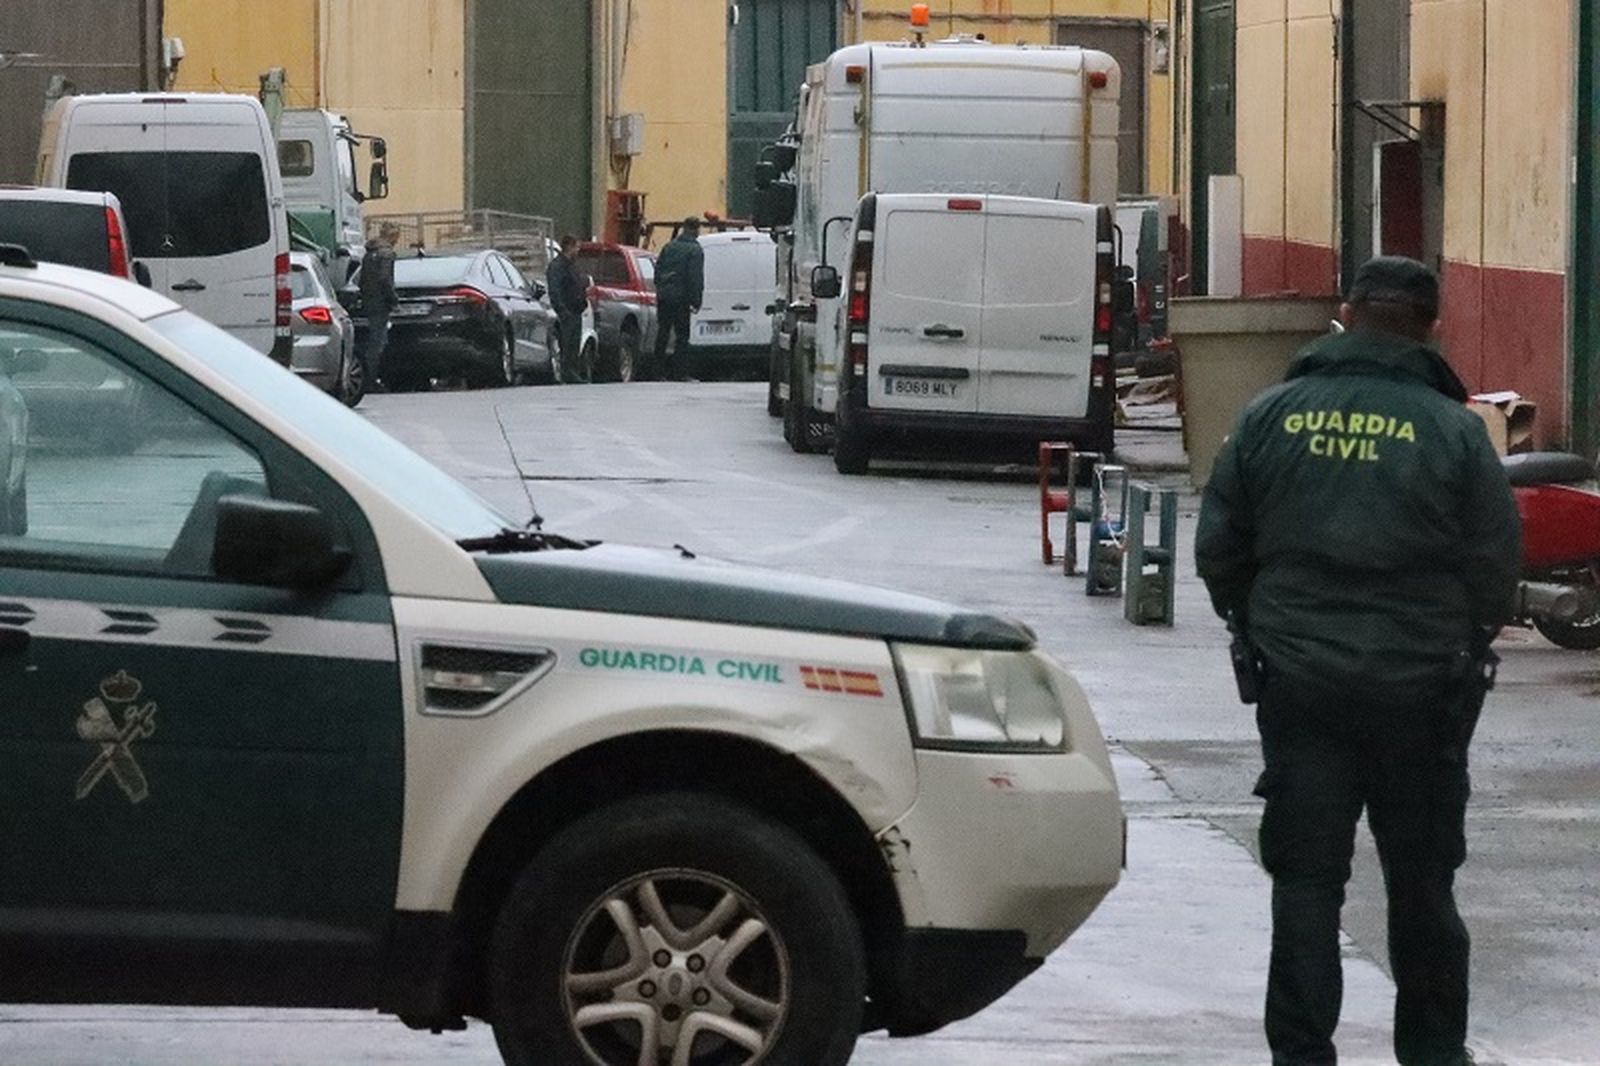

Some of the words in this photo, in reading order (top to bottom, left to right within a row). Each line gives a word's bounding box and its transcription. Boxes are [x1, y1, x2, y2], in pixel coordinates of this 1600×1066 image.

[1283, 410, 1416, 443] GUARDIA
[1309, 433, 1380, 461] CIVIL
[579, 647, 706, 675] GUARDIA
[716, 659, 784, 683] CIVIL
